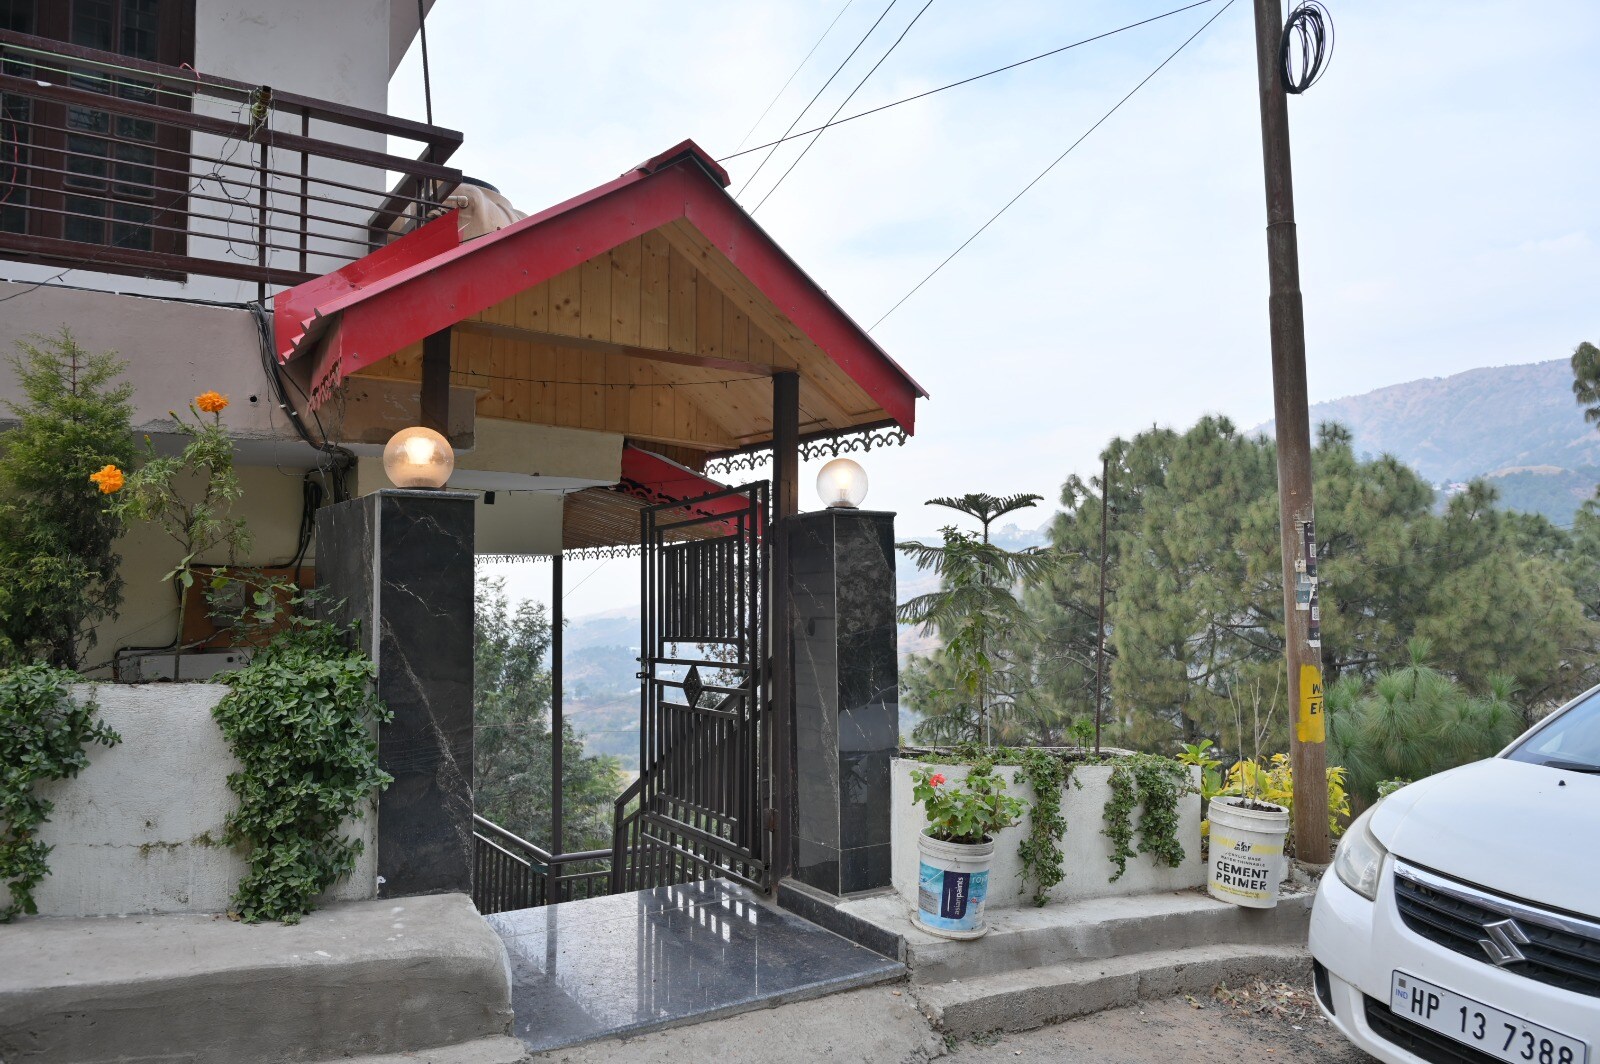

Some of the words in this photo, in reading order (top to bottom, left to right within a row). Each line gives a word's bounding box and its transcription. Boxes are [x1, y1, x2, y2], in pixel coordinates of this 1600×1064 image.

[1216, 860, 1269, 879] CEMENT
[1216, 871, 1267, 890] PRIMER
[1395, 988, 1408, 1000] IND
[1411, 986, 1440, 1019] HP
[1459, 1005, 1486, 1040] 13
[1502, 1022, 1573, 1064] 7388
